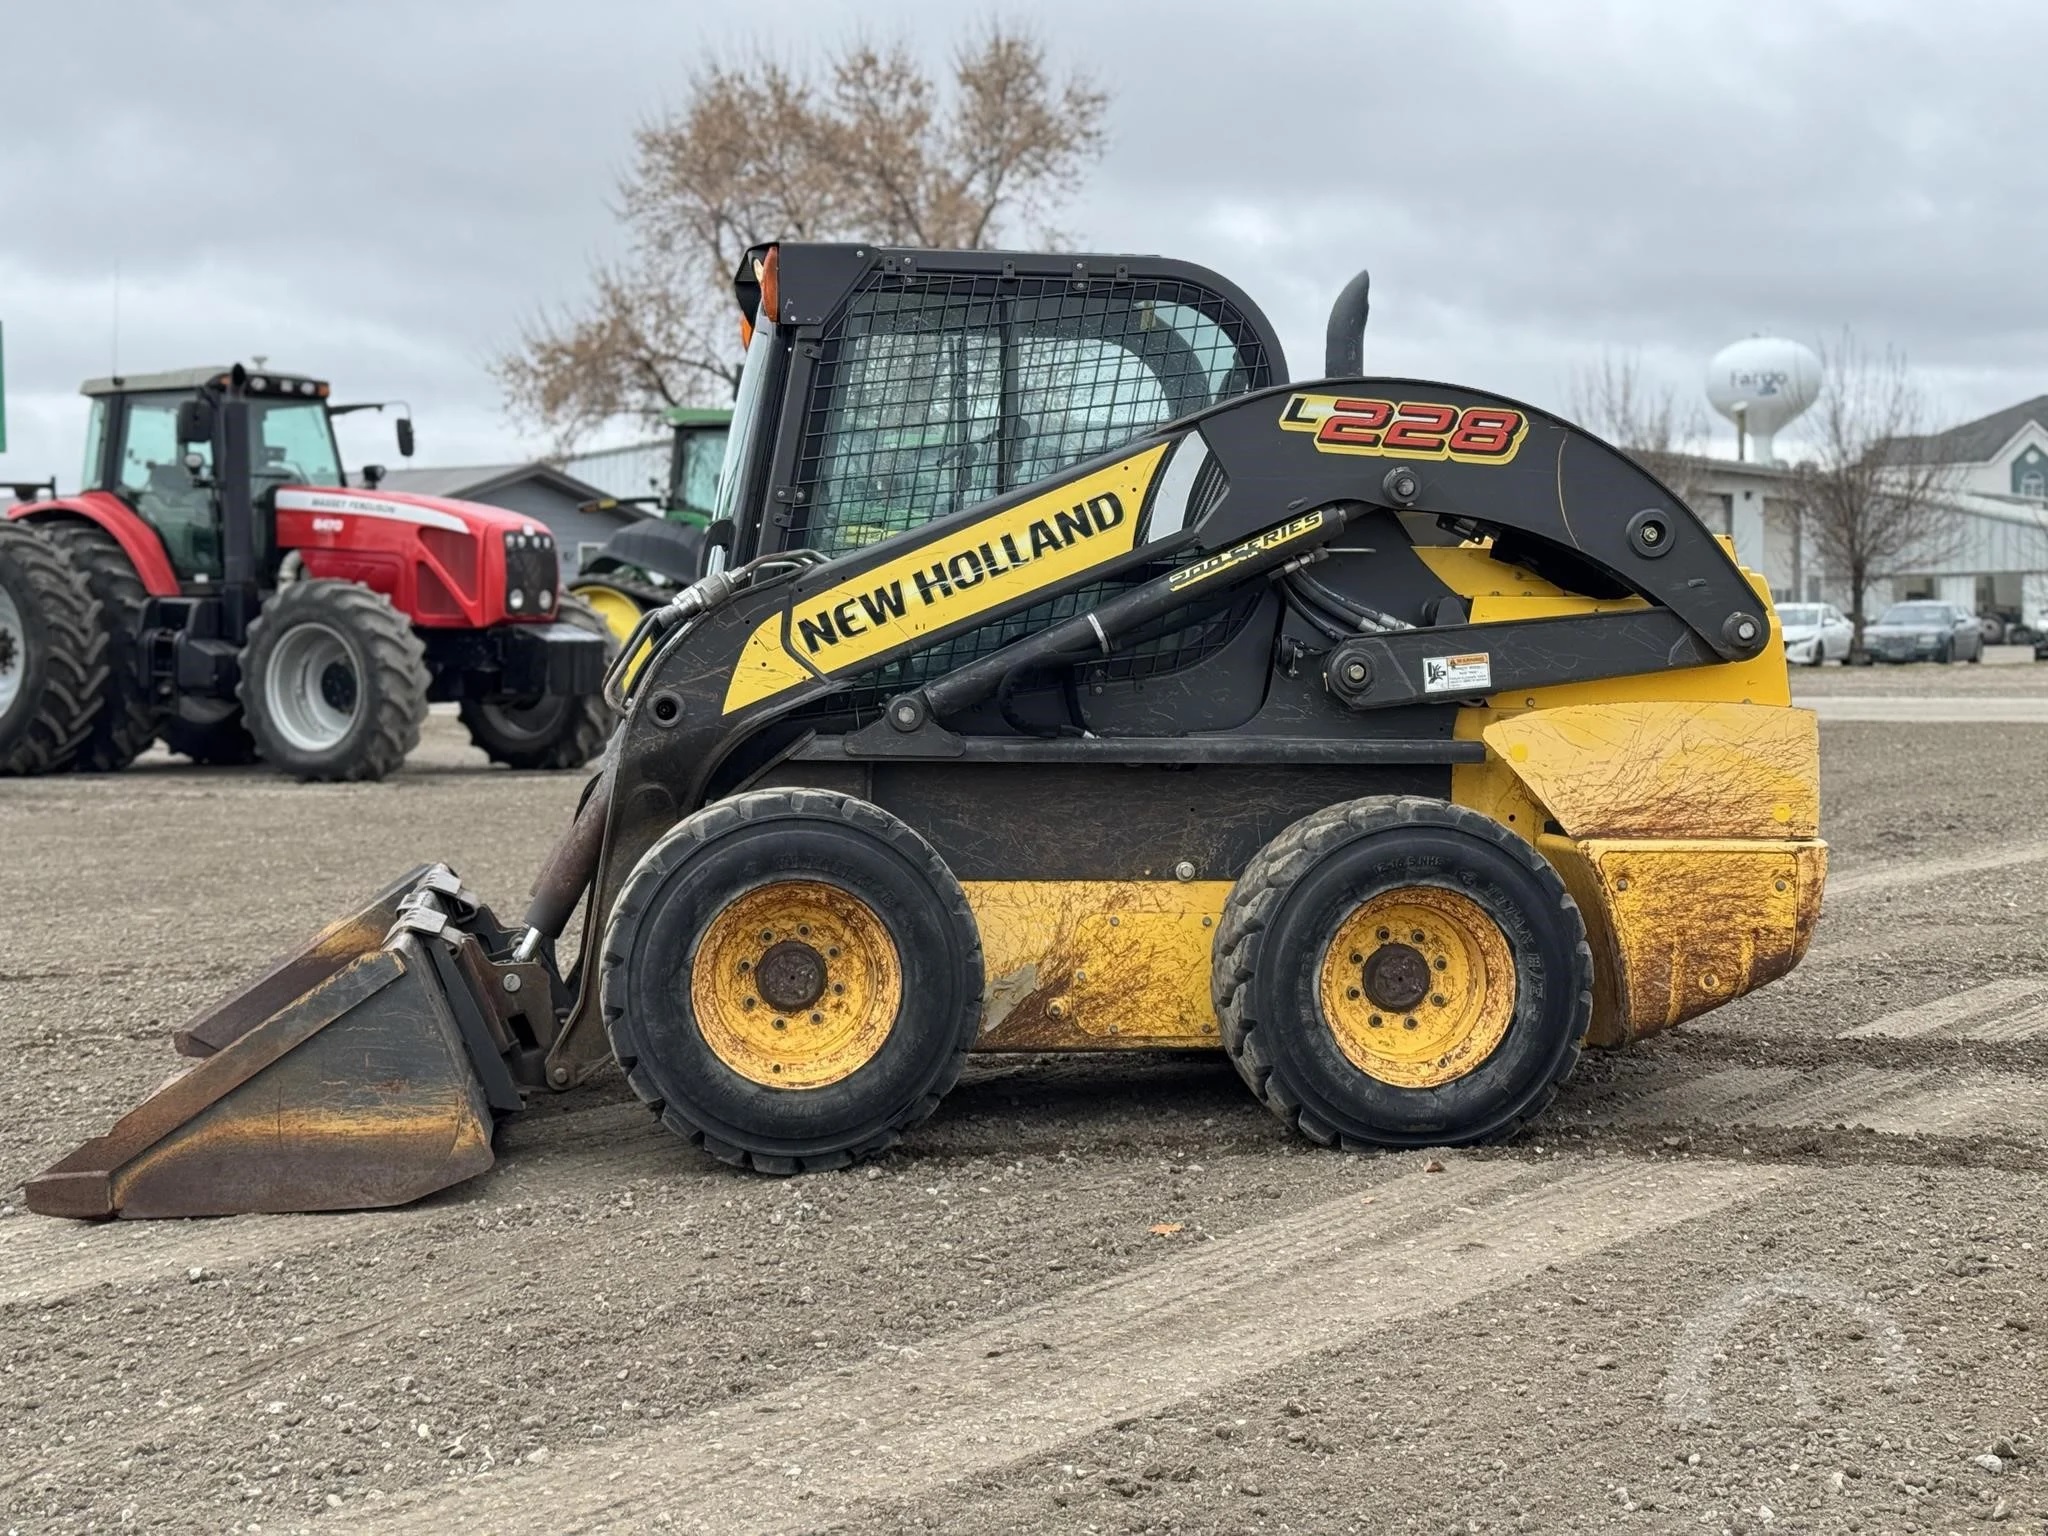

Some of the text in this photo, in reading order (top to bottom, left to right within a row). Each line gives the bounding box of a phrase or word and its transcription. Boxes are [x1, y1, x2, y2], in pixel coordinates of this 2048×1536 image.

[1730, 369, 1788, 395] Fargo
[348, 500, 396, 513] FERGUSON
[797, 490, 1125, 655] NEW HOLLAND
